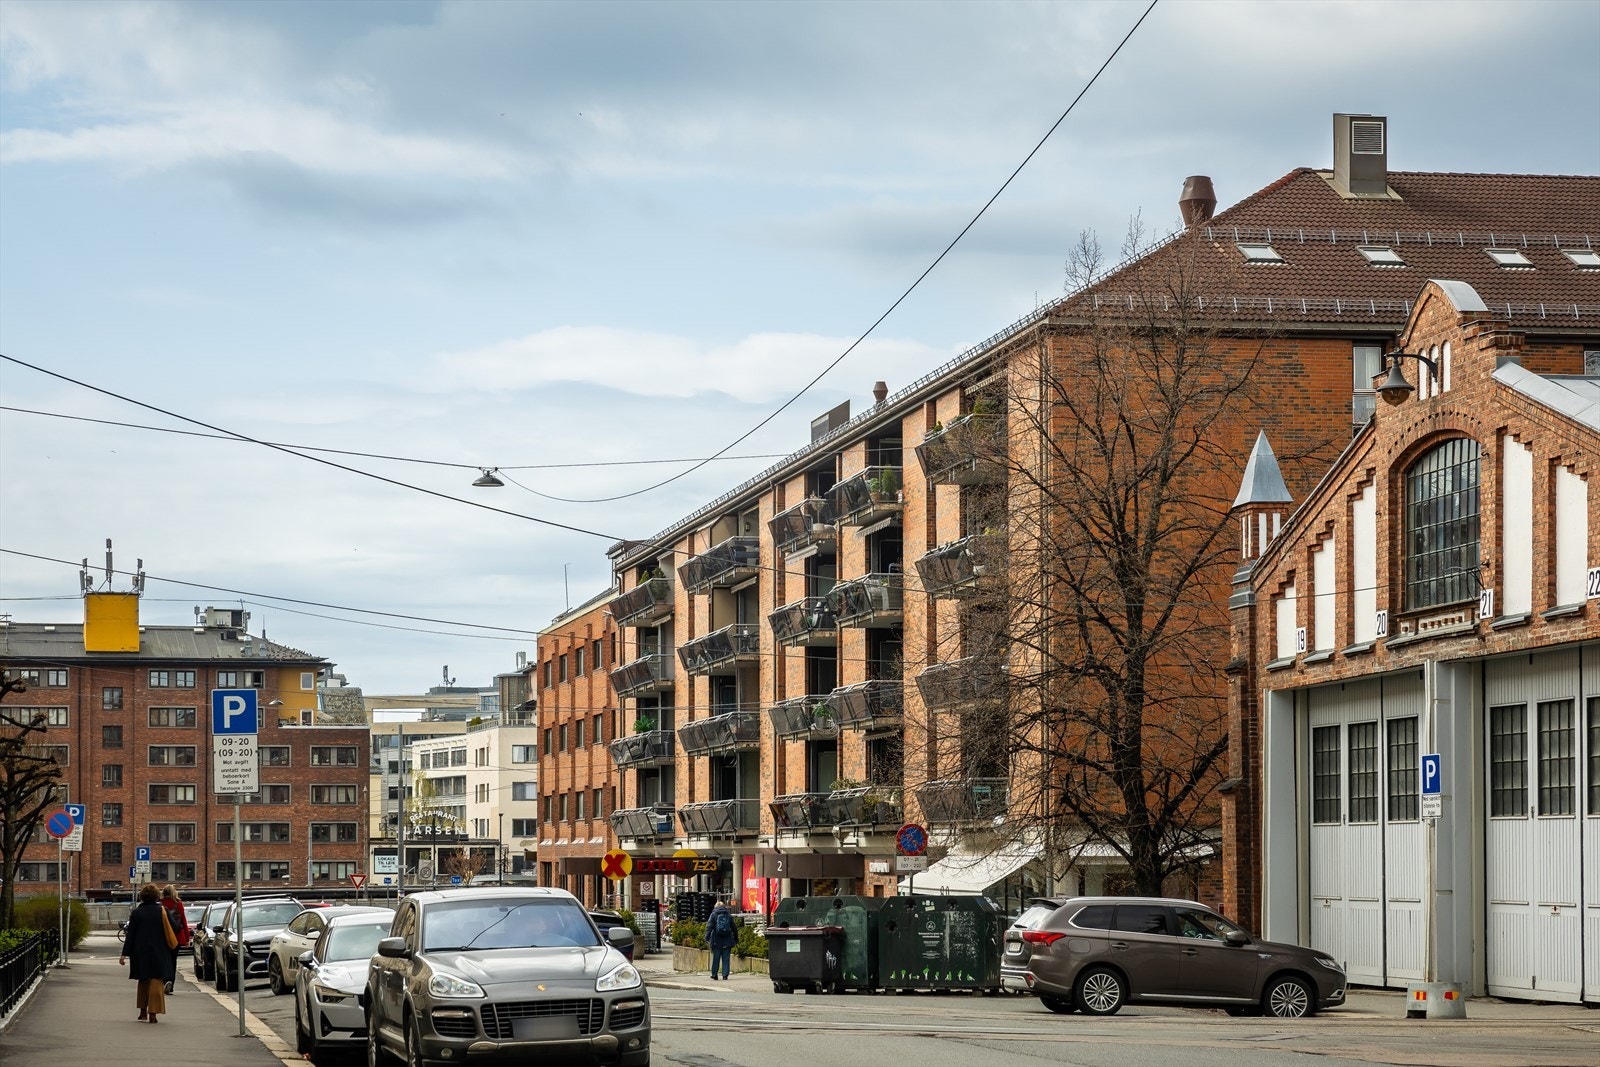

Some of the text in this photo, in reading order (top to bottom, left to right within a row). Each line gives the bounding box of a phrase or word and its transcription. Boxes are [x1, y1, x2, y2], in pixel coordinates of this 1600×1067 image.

[1588, 570, 1600, 596] 22
[1481, 592, 1491, 616] 21
[1376, 612, 1386, 636] 20
[1297, 629, 1305, 650] 19
[224, 696, 246, 728] P
[1426, 760, 1436, 788] P
[410, 810, 458, 822] RESTAURANT
[404, 826, 464, 835] LARSEN
[140, 849, 147, 859] P
[637, 860, 718, 872] EXTRA 7-23
[777, 860, 782, 872] 2
